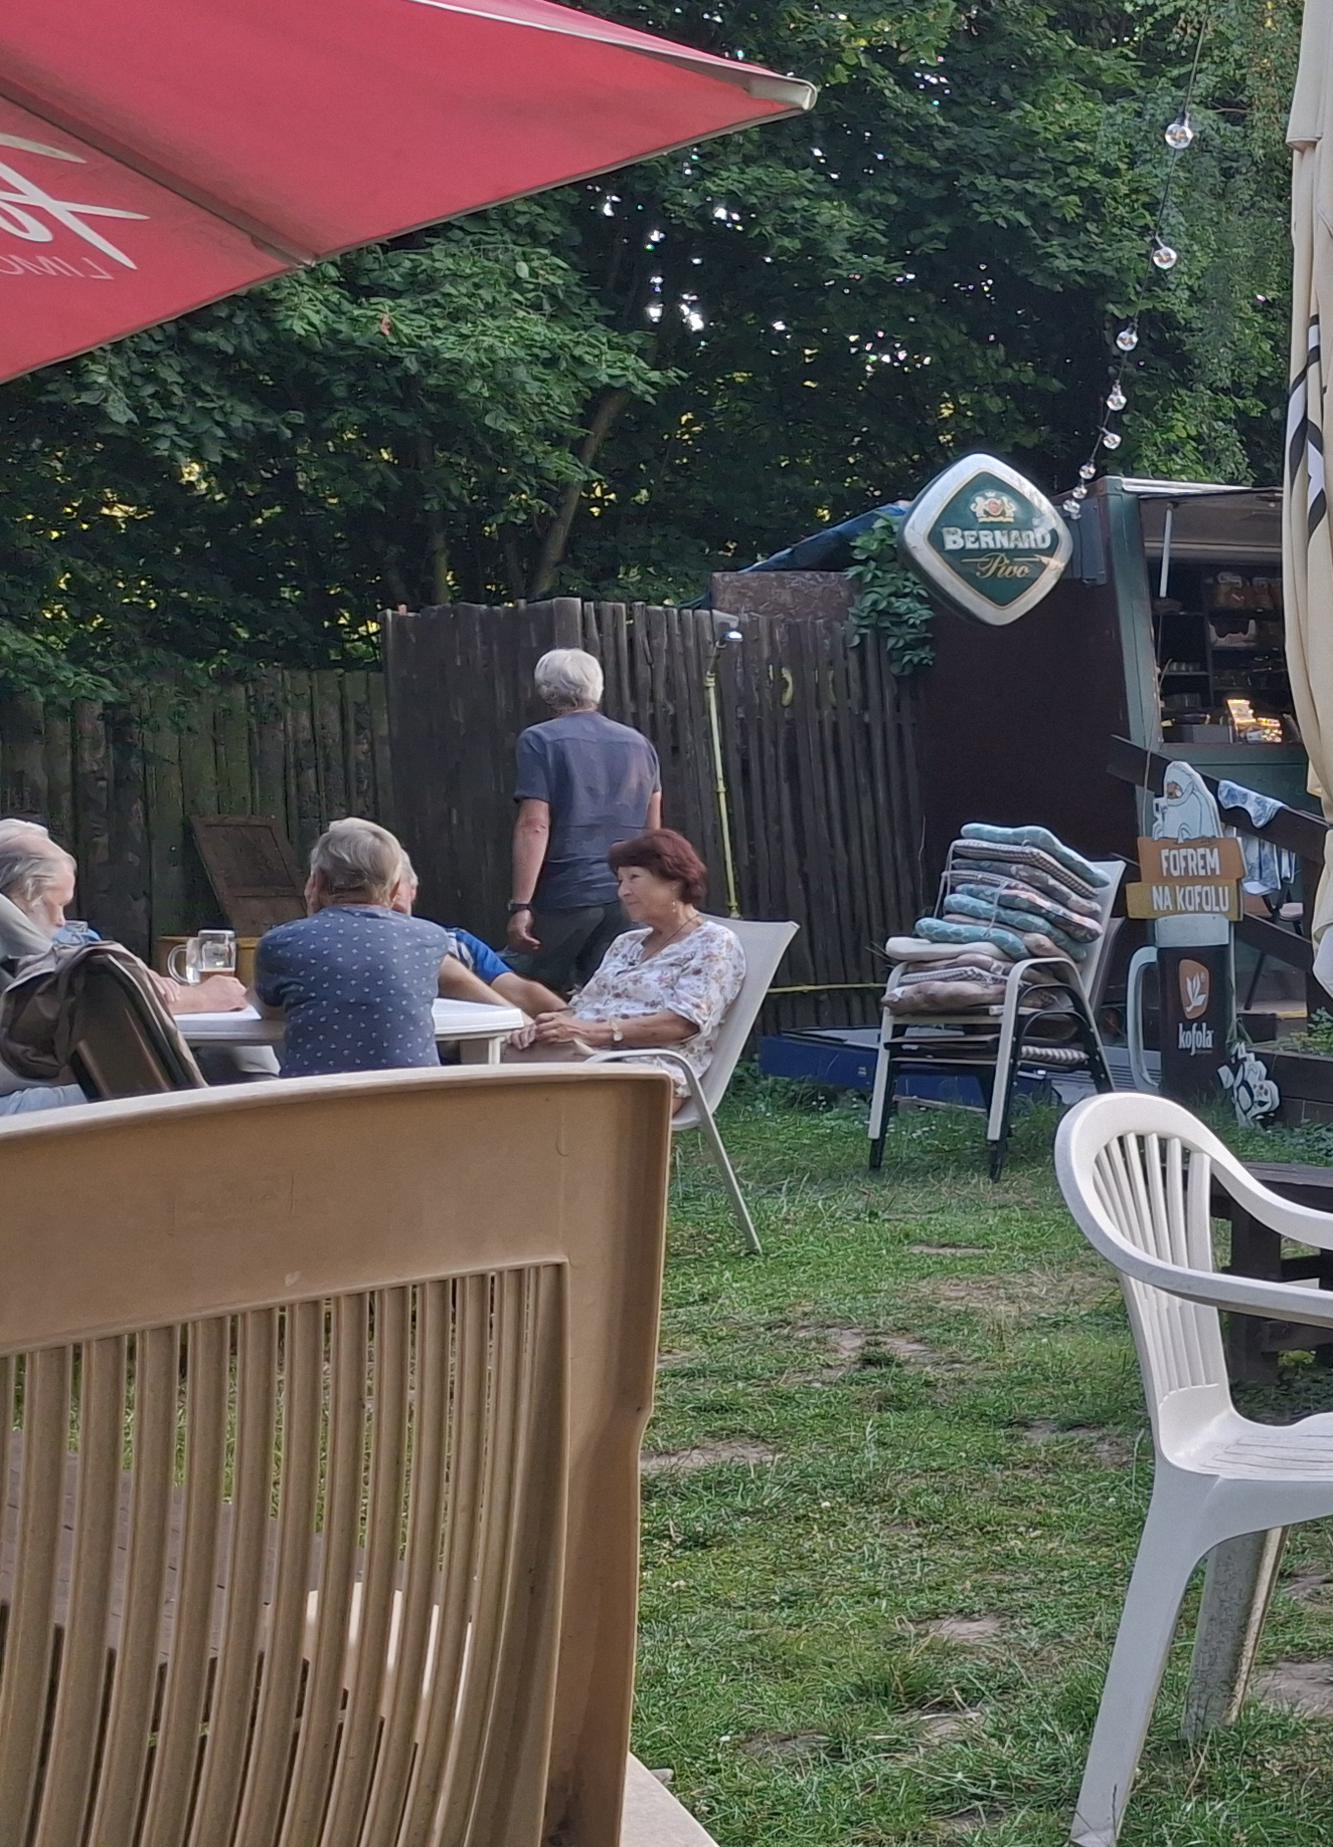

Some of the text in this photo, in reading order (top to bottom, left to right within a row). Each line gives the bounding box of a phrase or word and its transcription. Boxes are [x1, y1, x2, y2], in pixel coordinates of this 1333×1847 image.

[941, 527, 1052, 551] BERNARD
[975, 552, 1032, 579] Pivo
[1160, 847, 1221, 878] FOFREM
[1152, 884, 1230, 913] NA KOFOLU
[1177, 1022, 1213, 1056] kofola
